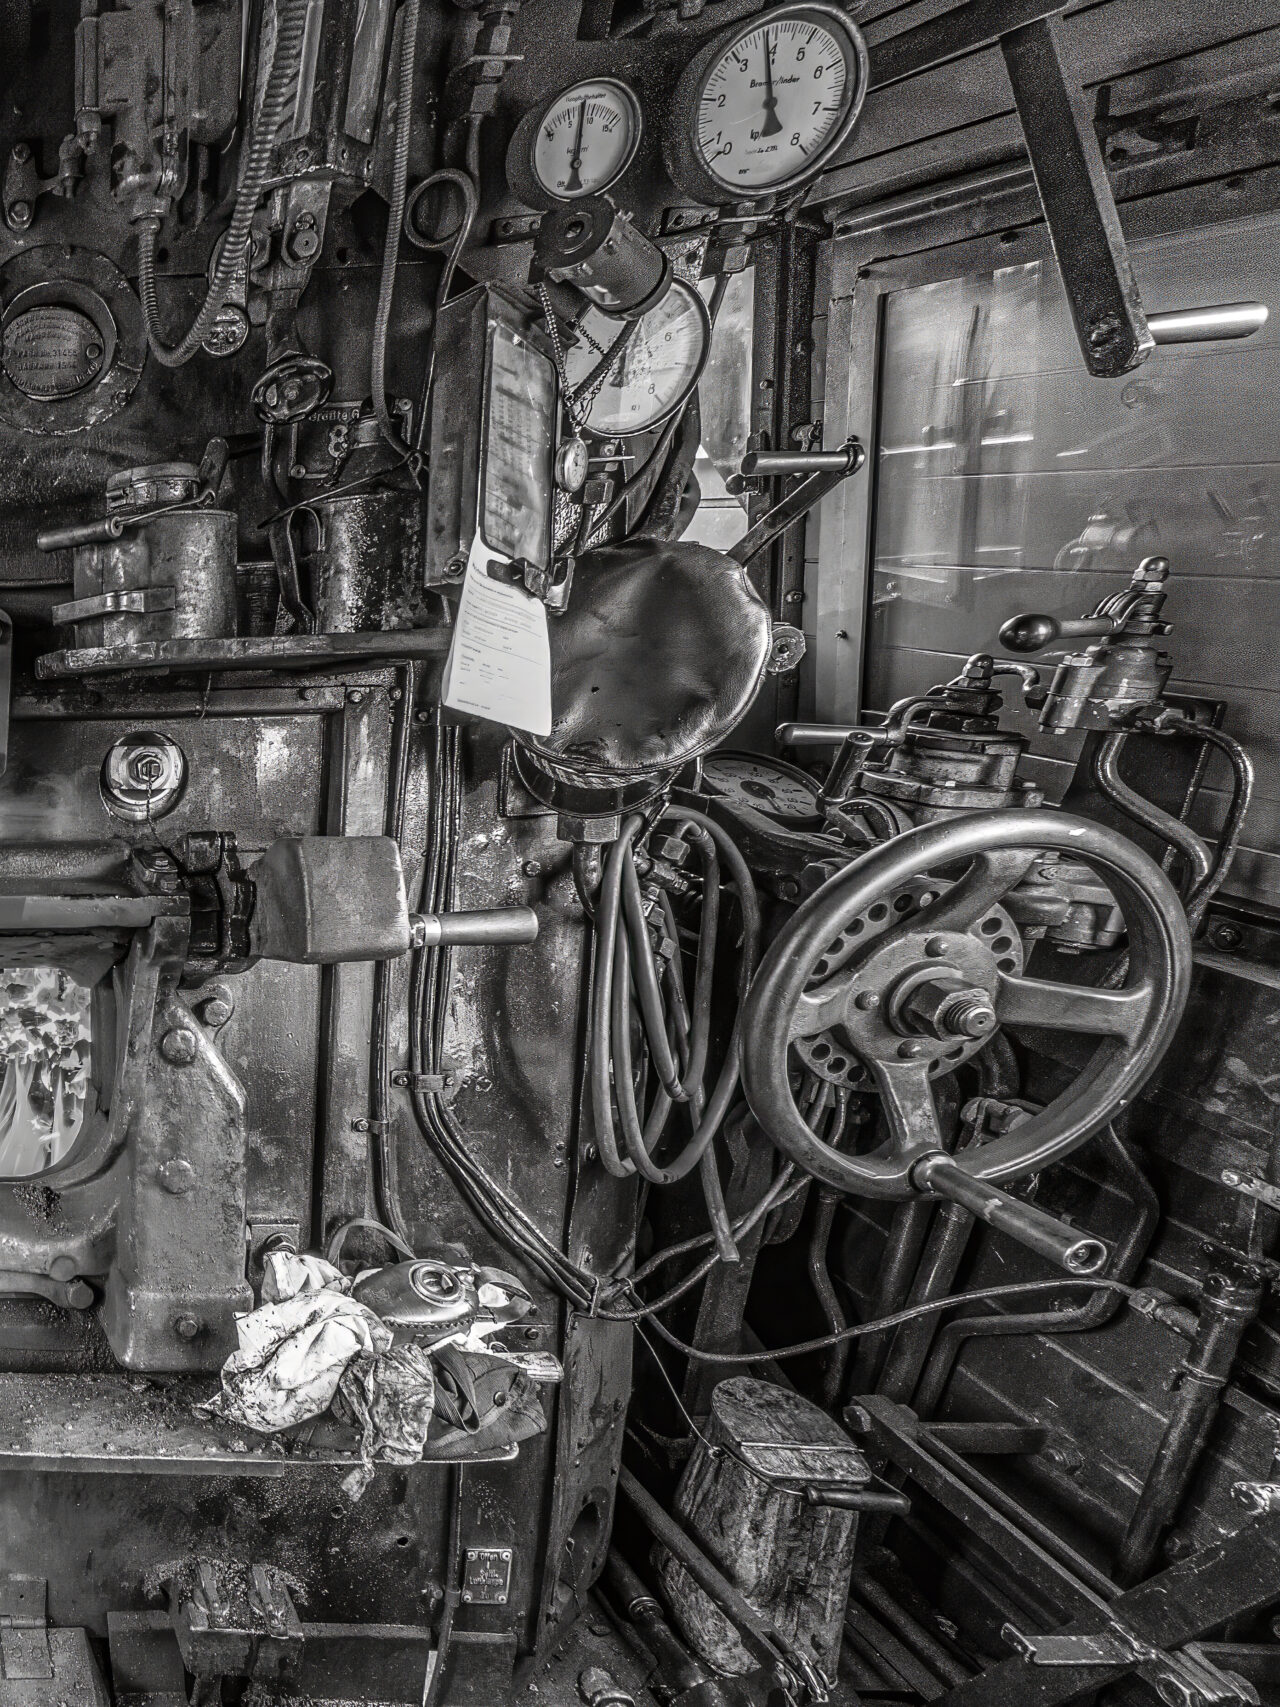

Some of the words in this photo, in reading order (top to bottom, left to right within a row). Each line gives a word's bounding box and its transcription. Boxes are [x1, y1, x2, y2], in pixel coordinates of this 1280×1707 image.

[795, 47, 806, 62] 5
[739, 58, 749, 73] 3
[813, 65, 823, 79] 6
[717, 94, 726, 108] 2
[812, 101, 822, 115] 7
[567, 120, 573, 129] 5
[586, 117, 594, 125] 10
[716, 131, 723, 145] 1
[790, 132, 800, 146] 8
[723, 142, 733, 156] 0
[664, 331, 672, 342] 6
[647, 383, 656, 395] 8
